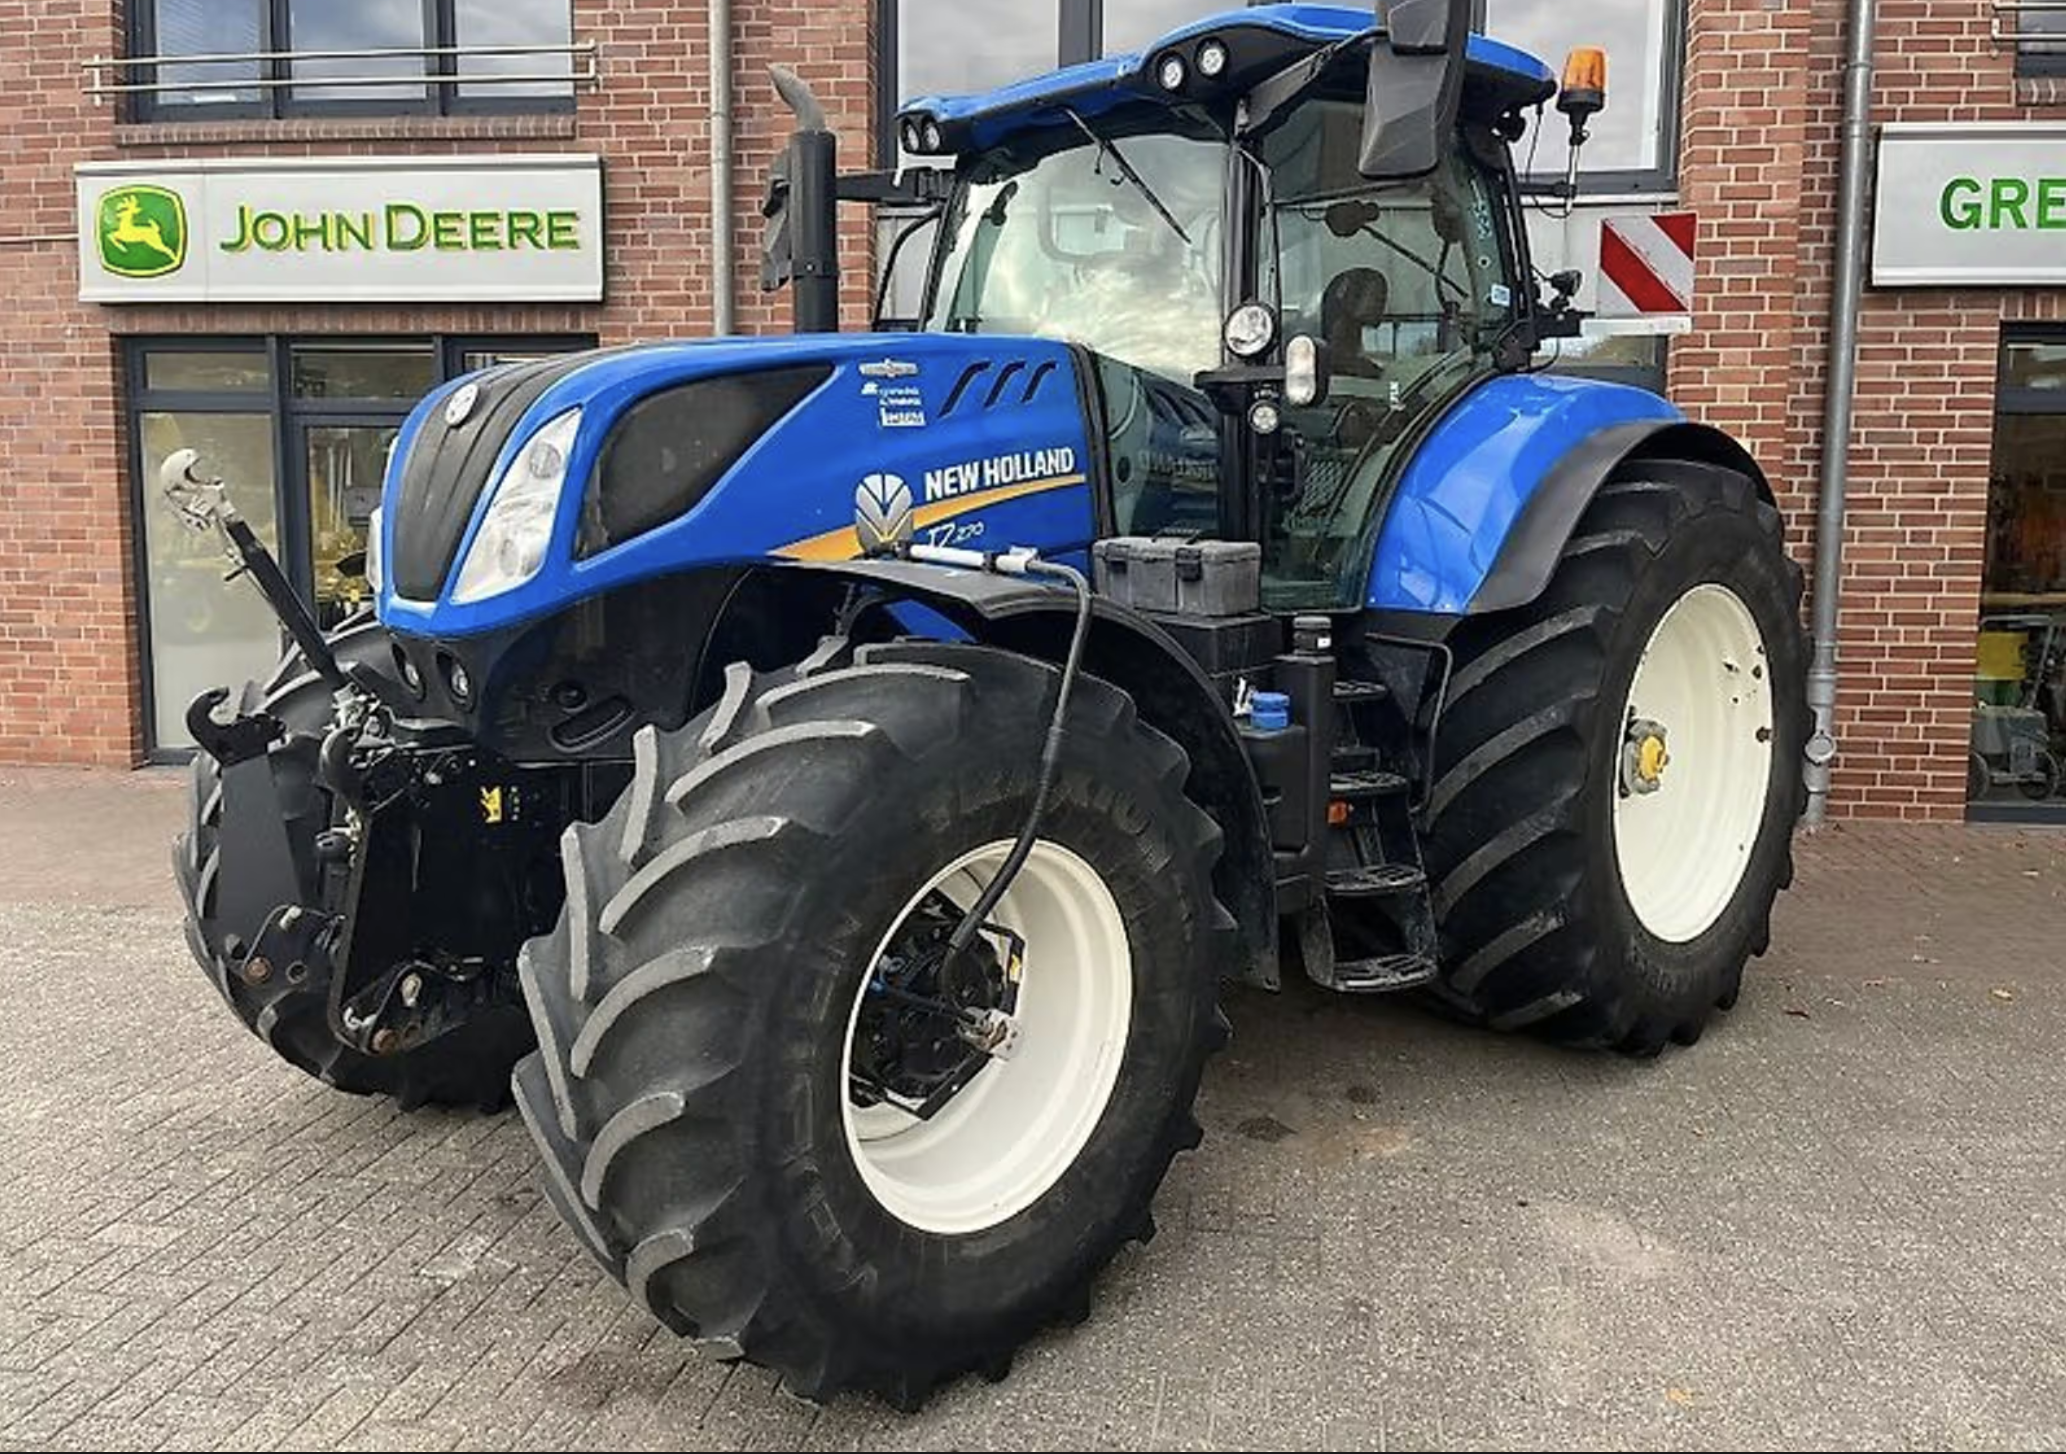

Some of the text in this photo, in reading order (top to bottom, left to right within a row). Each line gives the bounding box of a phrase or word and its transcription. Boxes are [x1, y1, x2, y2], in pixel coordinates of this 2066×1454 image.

[219, 202, 581, 252] JOHN DEERE
[924, 446, 1075, 501] NEW HOLLAND
